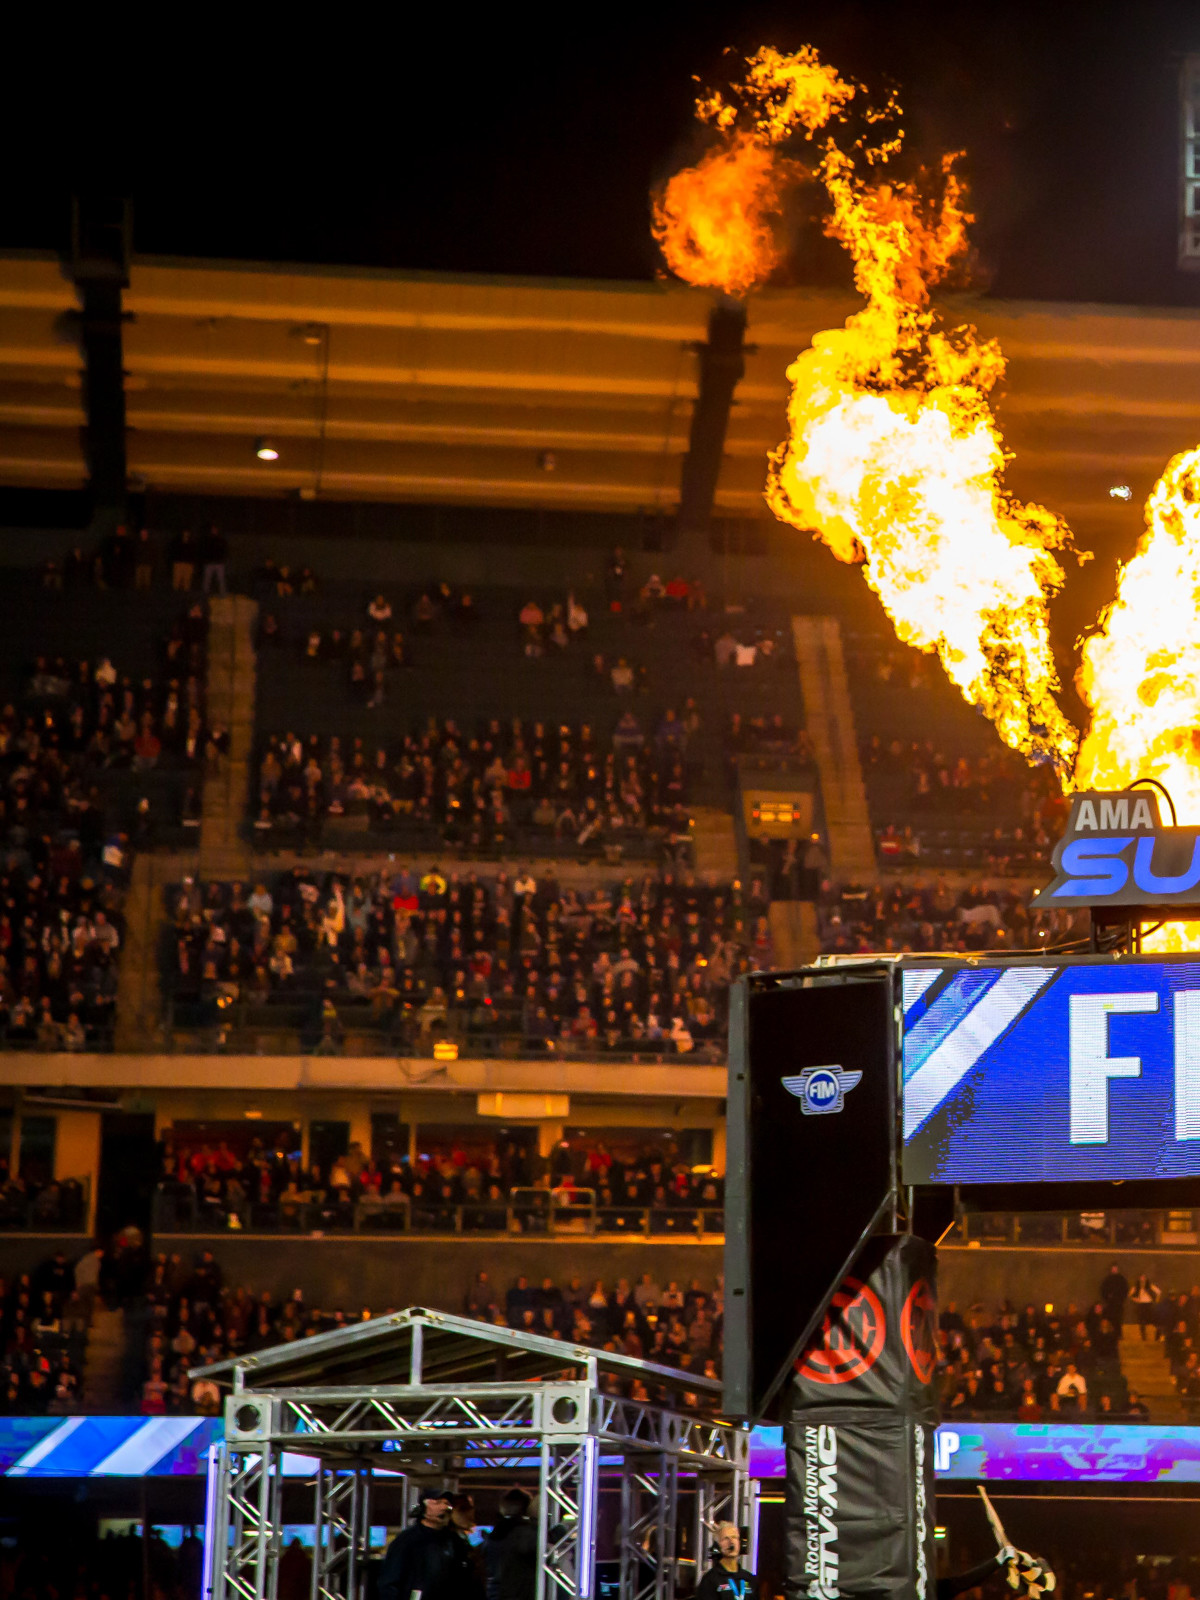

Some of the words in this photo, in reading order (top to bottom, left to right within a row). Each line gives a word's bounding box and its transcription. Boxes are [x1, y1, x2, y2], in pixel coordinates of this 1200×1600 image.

[1075, 798, 1154, 831] AMA
[809, 1080, 835, 1099] FIM
[804, 1426, 819, 1517] MOUNTAIN
[805, 1520, 819, 1576] ROCKY
